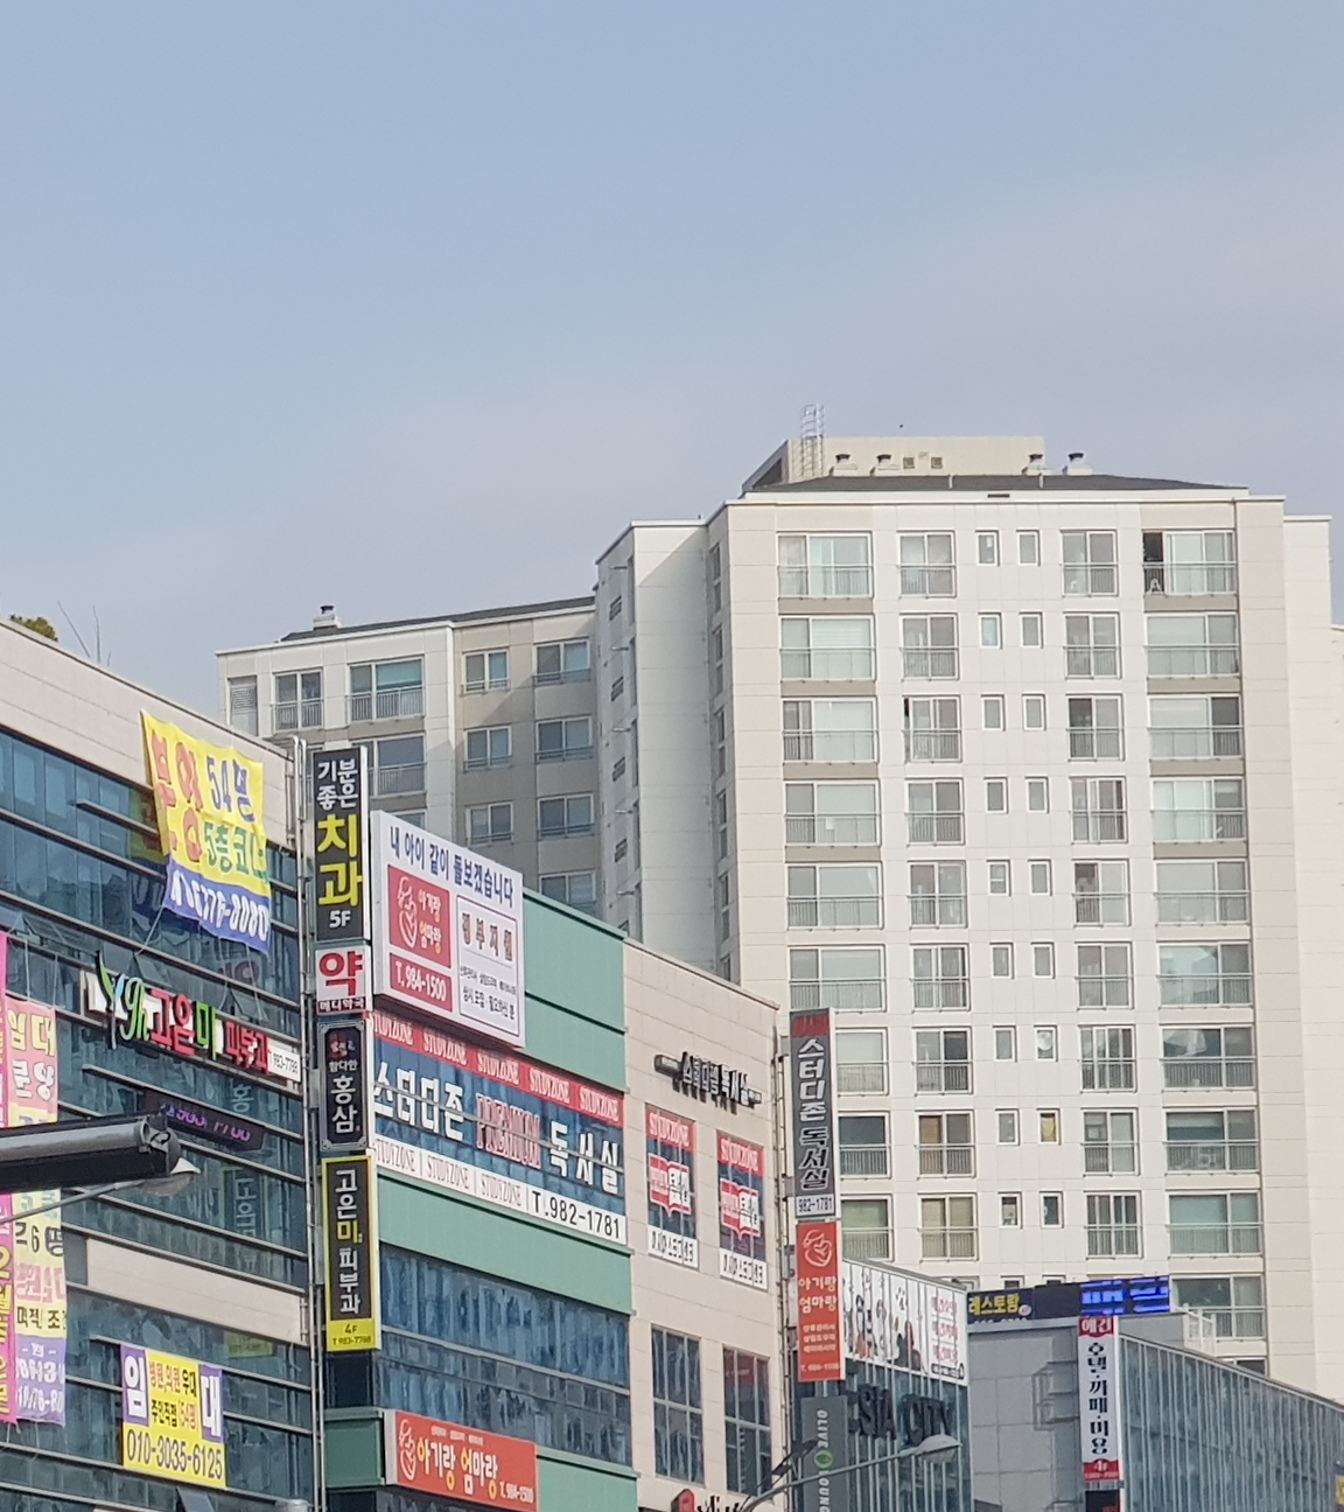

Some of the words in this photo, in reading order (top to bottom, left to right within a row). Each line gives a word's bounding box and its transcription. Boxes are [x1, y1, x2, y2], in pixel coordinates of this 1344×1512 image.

[317, 813, 362, 907] 치과
[391, 826, 401, 858] 내
[404, 832, 426, 870] 아이
[429, 844, 450, 882] 같이
[454, 855, 515, 908] 돌보겠습니다
[329, 909, 351, 930] 5F
[320, 951, 363, 998] 약
[331, 1074, 358, 1135] 홍삼
[797, 1038, 826, 1122] 스터디존
[373, 1061, 465, 1141] 스터디존
[550, 1120, 619, 1195] 독서실
[799, 1126, 831, 1192] 독서실
[339, 1247, 361, 1315] 피부과
[798, 1277, 838, 1293] 아기랑
[798, 1295, 838, 1314] 엄마랑
[968, 1293, 1021, 1316] 레스토랑
[127, 1429, 224, 1480] 010-3035-6125
